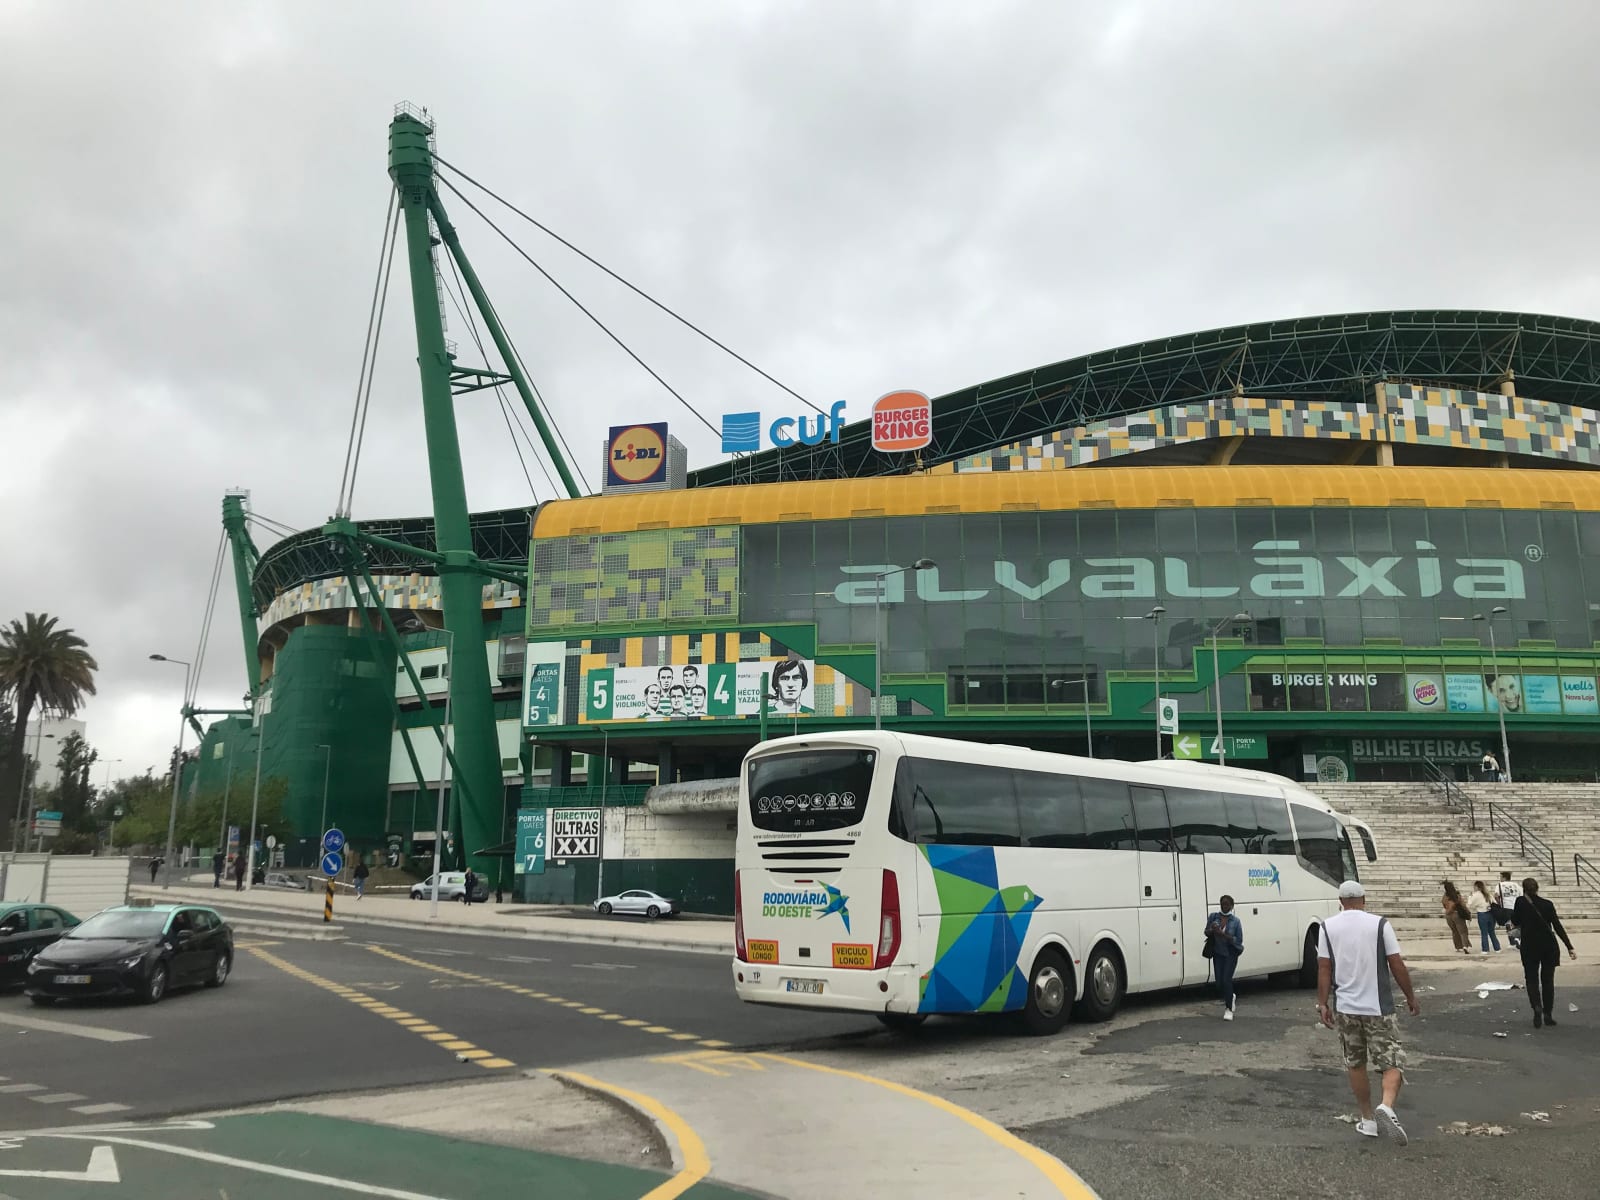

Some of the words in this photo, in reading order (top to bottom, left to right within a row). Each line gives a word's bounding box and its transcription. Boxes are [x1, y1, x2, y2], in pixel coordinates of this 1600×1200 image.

[769, 400, 846, 448] cuf
[874, 408, 929, 424] BURGER
[874, 421, 930, 441] KING
[1272, 674, 1334, 686] BURGER
[1339, 674, 1378, 686] KING
[536, 686, 546, 701] 4
[593, 680, 608, 709] 5
[713, 674, 731, 704] 4
[530, 705, 540, 720] 5
[1210, 735, 1226, 754] 4
[1351, 739, 1482, 757] BILHETEIRAS
[518, 815, 545, 823] PORTAS
[554, 821, 599, 835] ULTRAS
[534, 833, 544, 849] 6
[556, 838, 595, 855] XXI
[526, 854, 537, 871] 7
[763, 889, 828, 905] RODOVIÁRIA
[762, 906, 775, 918] DO
[778, 906, 812, 918] OESTE
[752, 952, 773, 960] LONGO
[839, 957, 865, 965] LONGO
